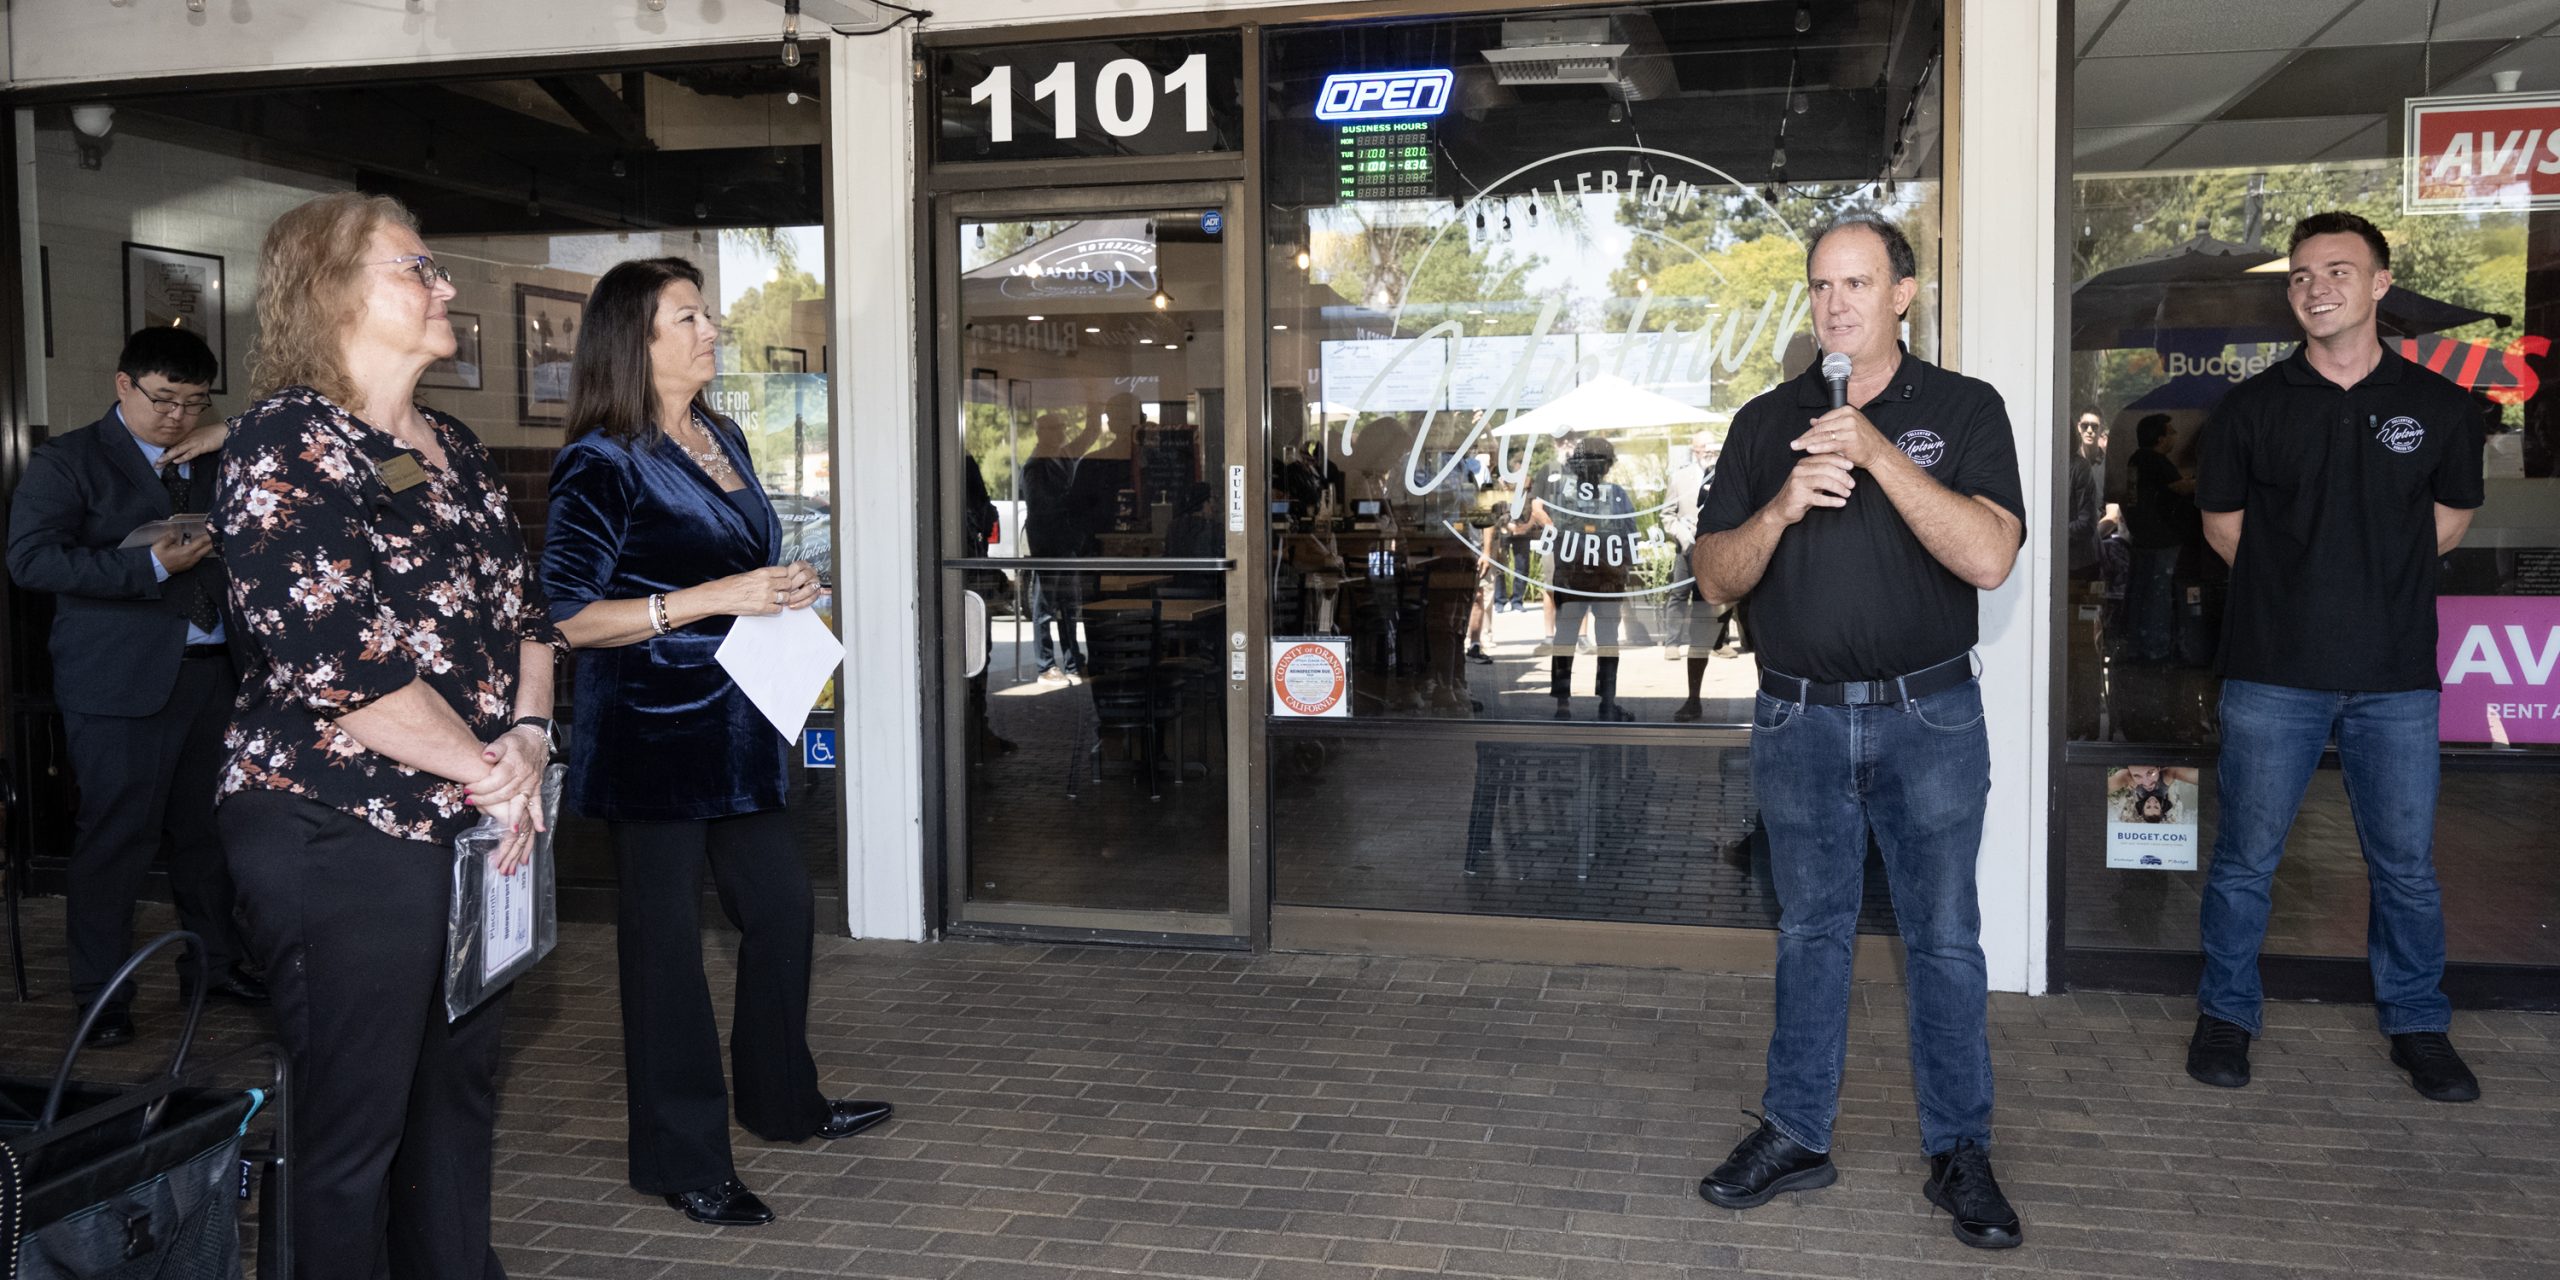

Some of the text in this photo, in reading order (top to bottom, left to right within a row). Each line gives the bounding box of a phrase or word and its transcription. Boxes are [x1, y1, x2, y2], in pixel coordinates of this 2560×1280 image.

[971, 53, 1207, 142] 1101
[1325, 78, 1443, 112] OPEN
[1342, 122, 1428, 133] BUSINESS HOURS
[2432, 127, 2560, 178] AVIS
[1204, 217, 1220, 226] ADT
[2401, 335, 2552, 403] VIS
[727, 391, 750, 411] FOR
[2376, 427, 2424, 446] Uptown
[1233, 467, 1242, 511] PULL
[1562, 478, 1622, 503] EST.
[1539, 524, 1667, 567] BURGER
[1276, 646, 1303, 682] COUNTY
[1314, 646, 1343, 682] ORANGE
[1285, 695, 1337, 713] CALIFORNIA
[2487, 703, 2547, 719] RENT
